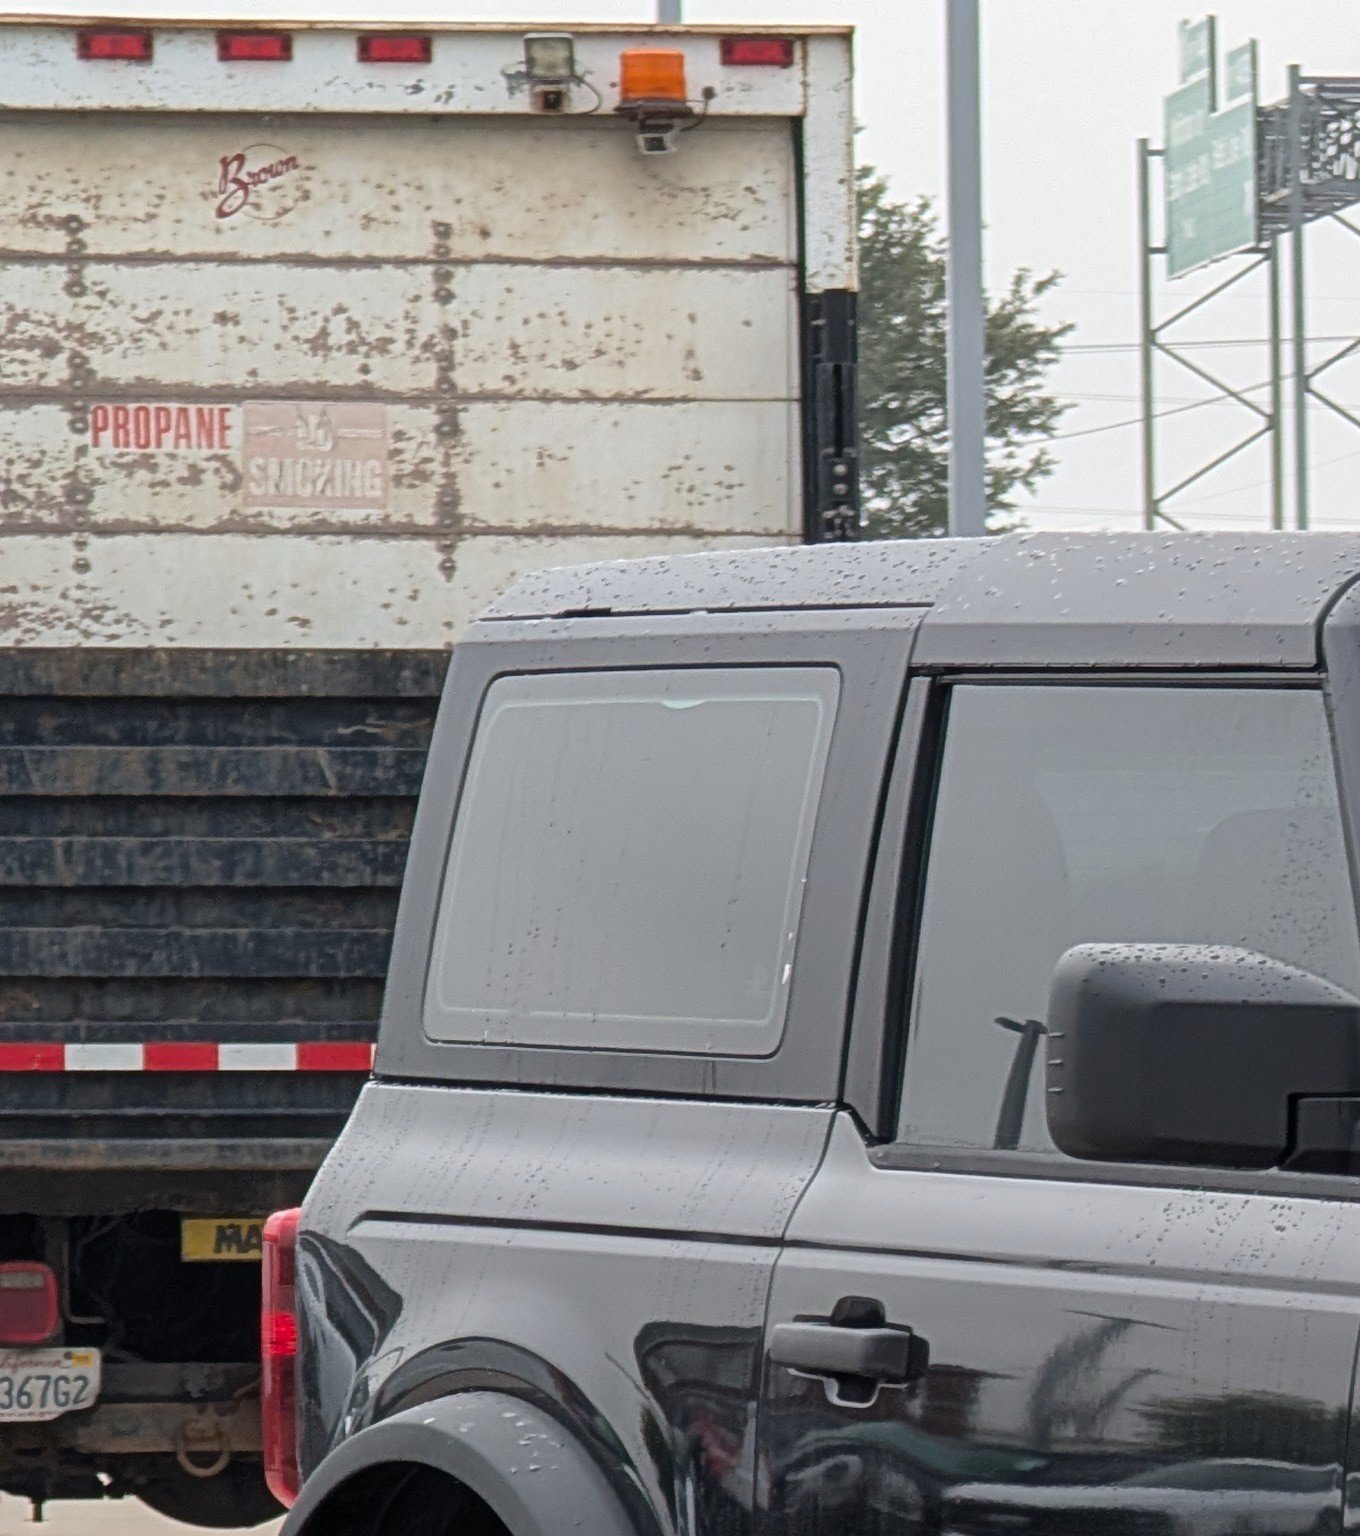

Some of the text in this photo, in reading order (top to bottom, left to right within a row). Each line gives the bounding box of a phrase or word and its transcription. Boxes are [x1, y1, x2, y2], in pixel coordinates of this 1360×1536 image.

[215, 153, 300, 218] Brown
[90, 405, 231, 450] PROPANE
[0, 1375, 88, 1409] 367G2
